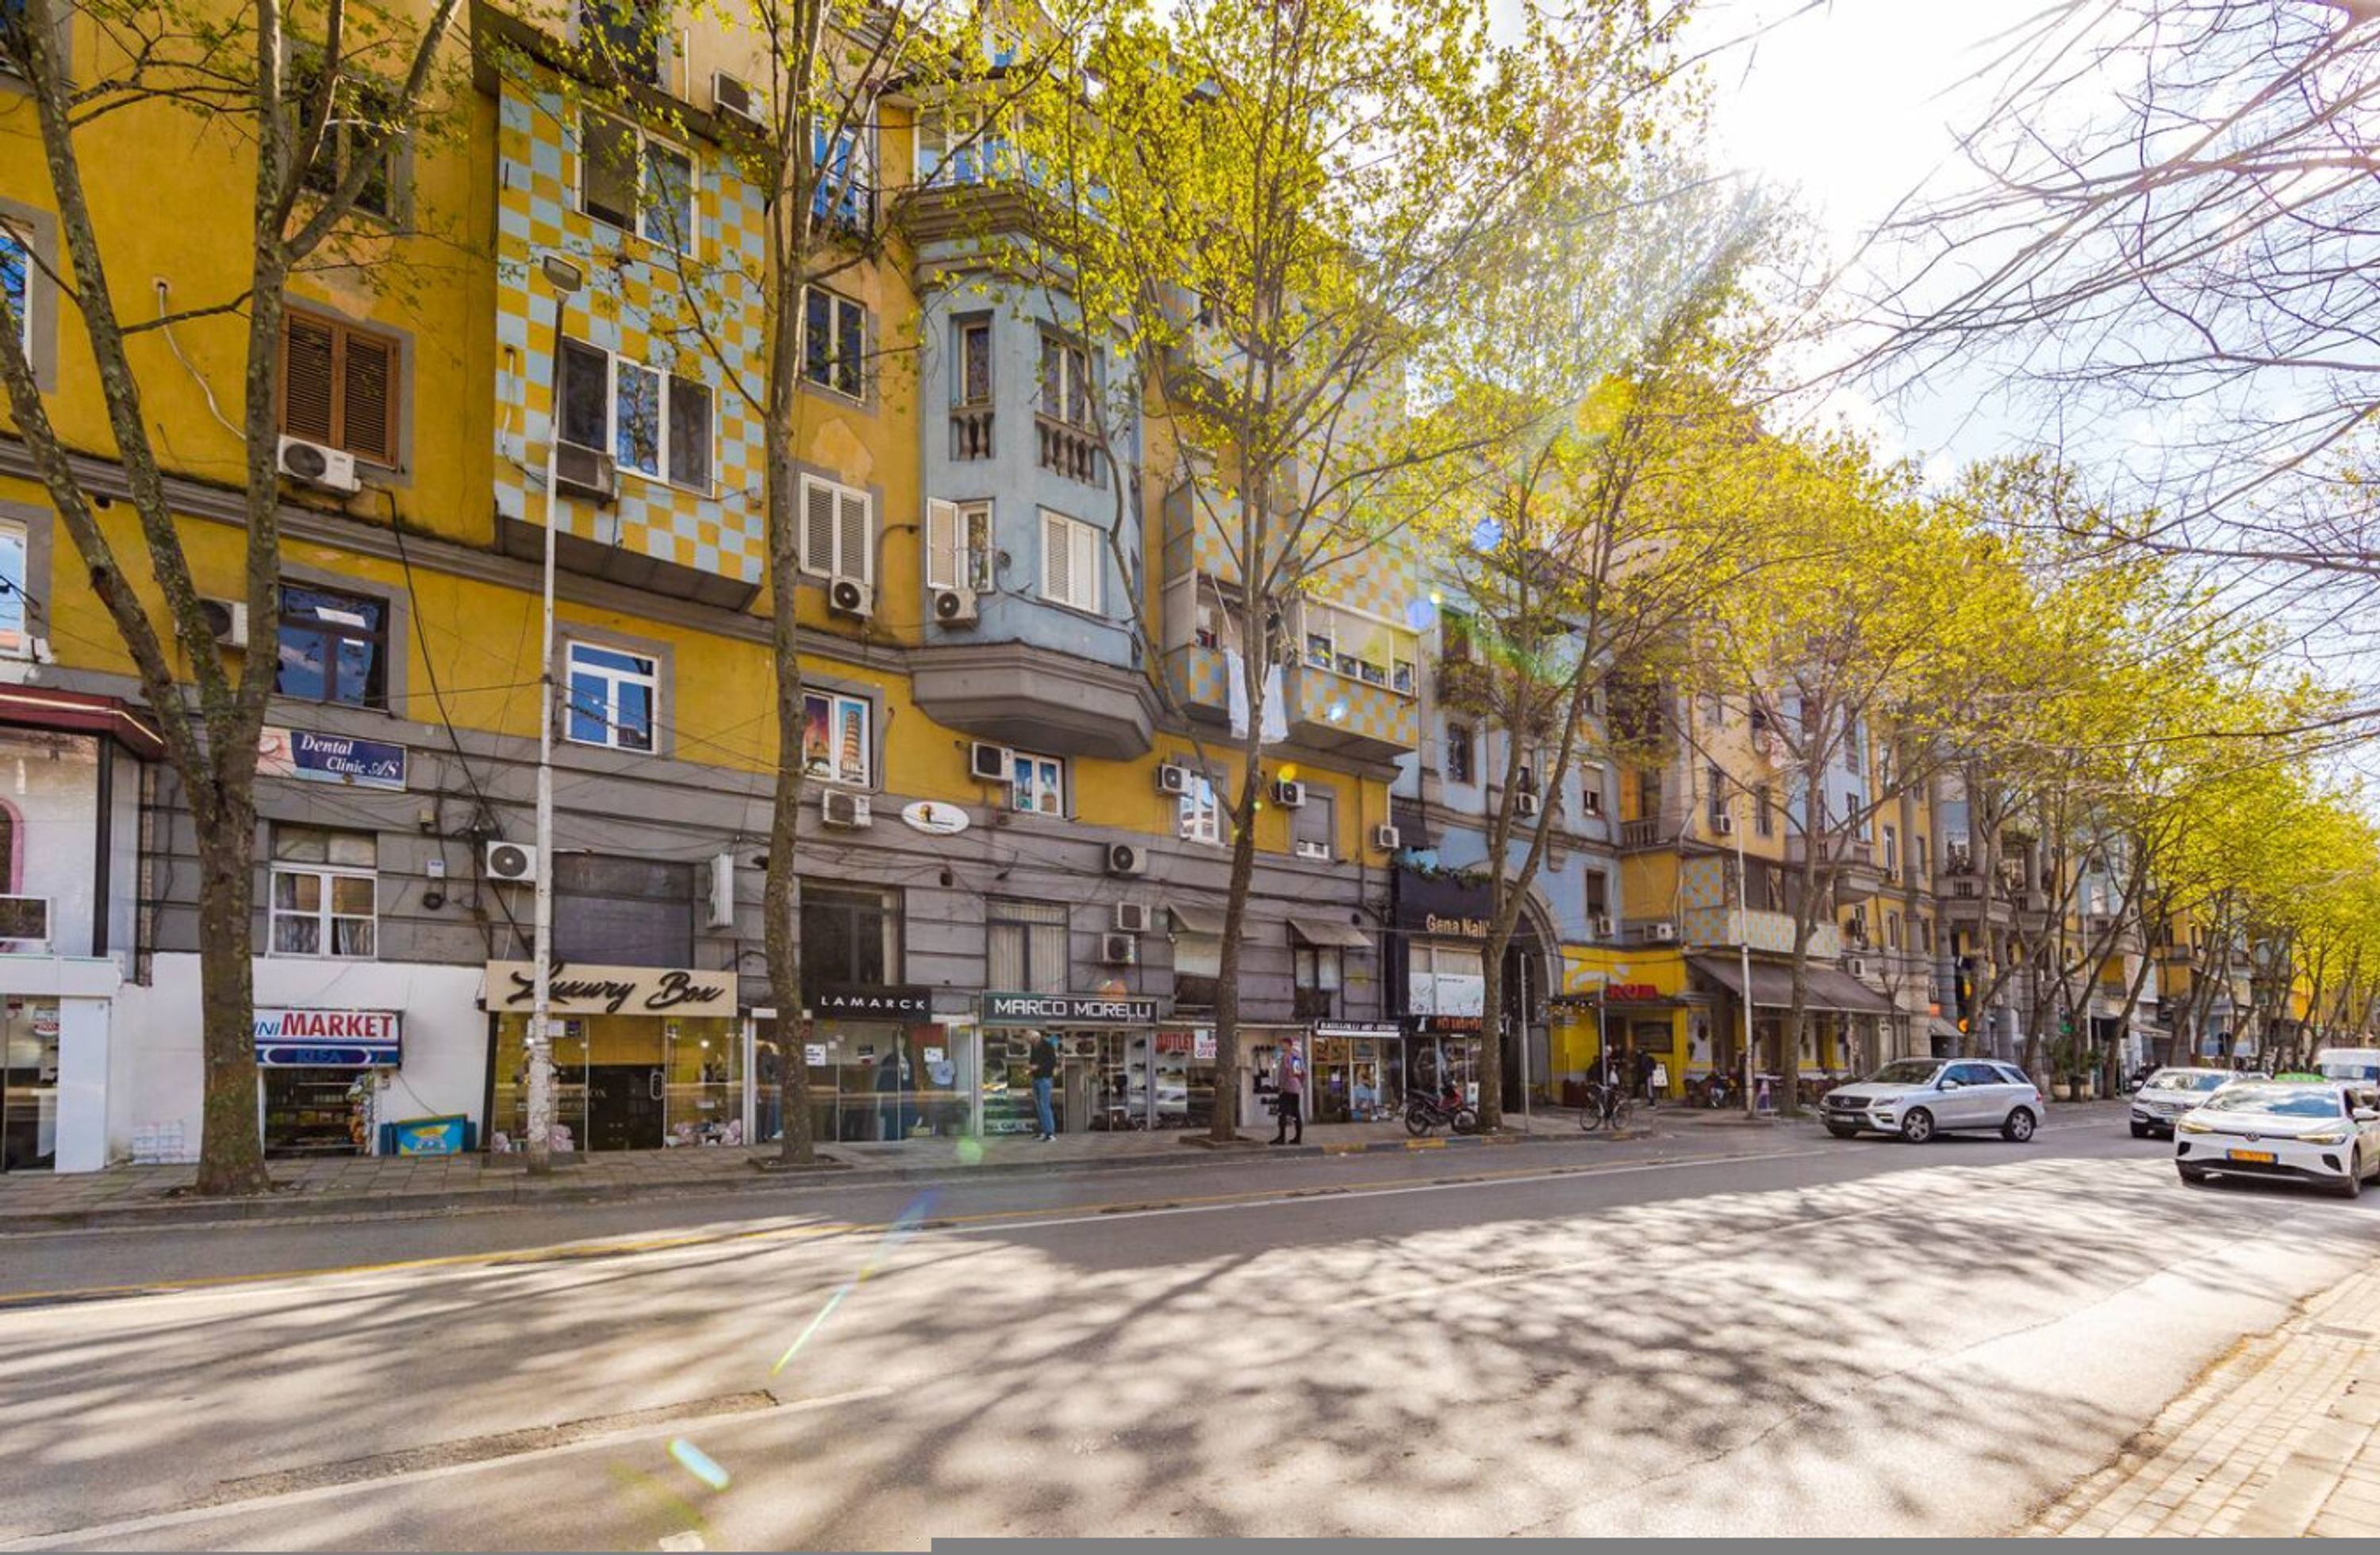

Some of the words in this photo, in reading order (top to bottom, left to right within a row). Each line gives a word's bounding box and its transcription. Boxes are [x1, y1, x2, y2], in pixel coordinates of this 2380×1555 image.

[301, 734, 354, 755] Dental
[326, 756, 367, 774] Clinic
[1462, 917, 1490, 938] Nail
[505, 959, 636, 1013] Luxury
[644, 970, 725, 1010] Box
[821, 995, 926, 1011] LAMARCK
[994, 998, 1068, 1016] MARCO
[1073, 1001, 1151, 1018] MORELLI
